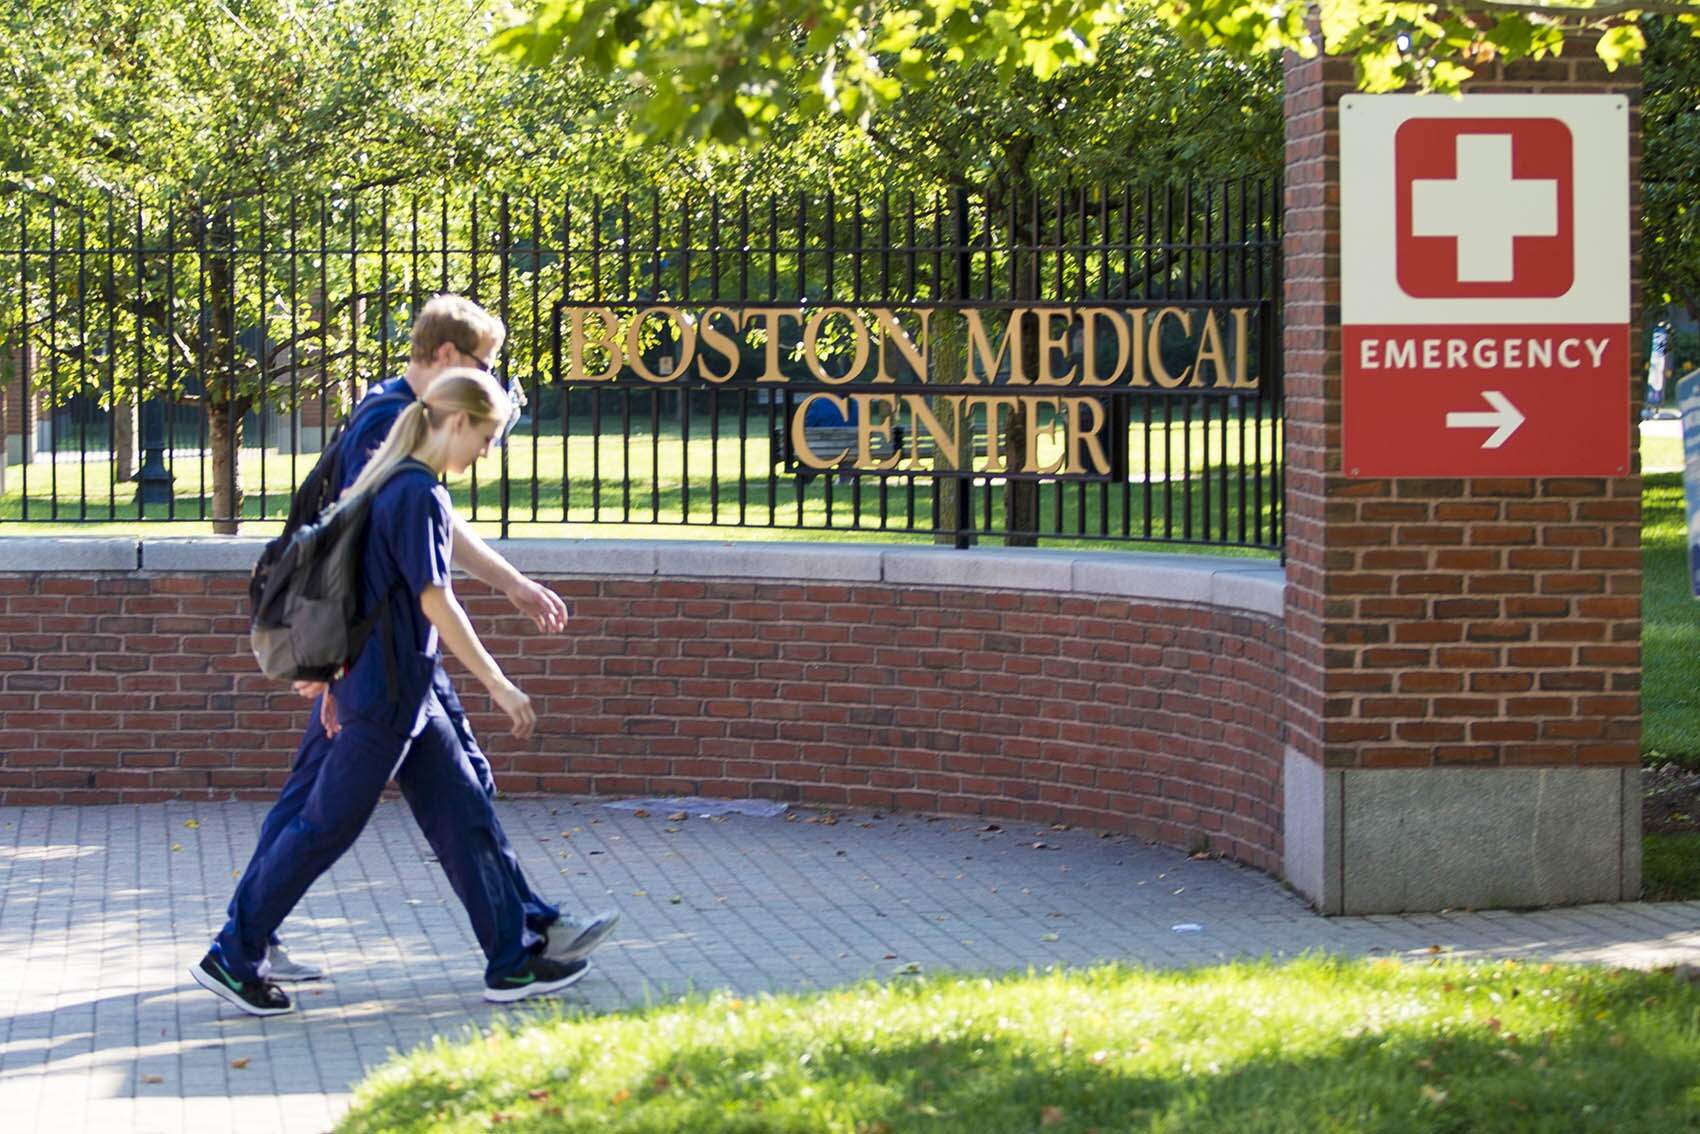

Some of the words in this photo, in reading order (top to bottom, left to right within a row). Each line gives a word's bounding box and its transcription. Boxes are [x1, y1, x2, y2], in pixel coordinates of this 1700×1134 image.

[559, 305, 934, 385] BOSTON
[958, 305, 1260, 389] MEDICAL
[1360, 338, 1610, 369] EMERGENCY
[791, 392, 1112, 476] CENTER
